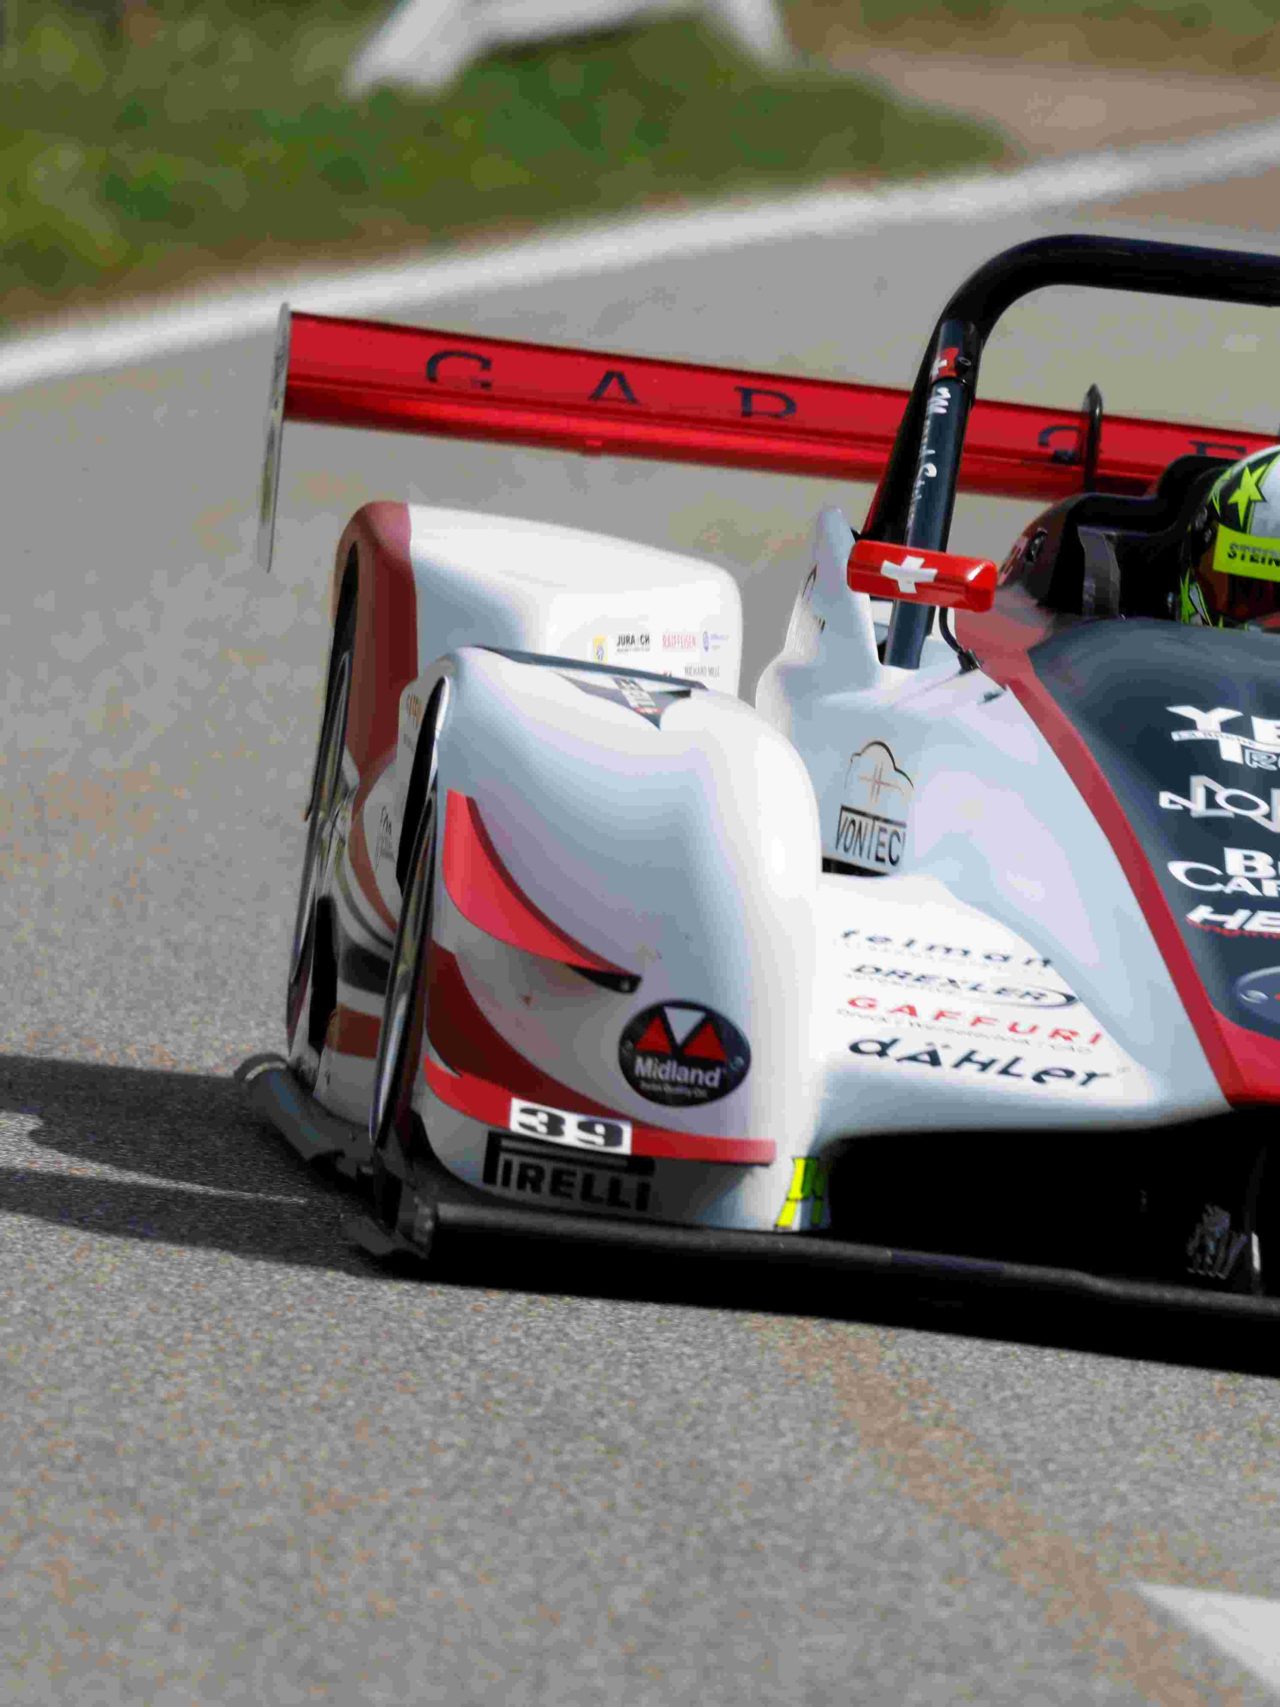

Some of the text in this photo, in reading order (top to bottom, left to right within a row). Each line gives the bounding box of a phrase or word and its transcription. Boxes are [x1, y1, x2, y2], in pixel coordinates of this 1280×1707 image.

[847, 995, 1102, 1046] GAFFURI
[634, 1054, 722, 1089] Midland
[517, 1105, 625, 1149] 39
[482, 1121, 657, 1213] PIRELLI
